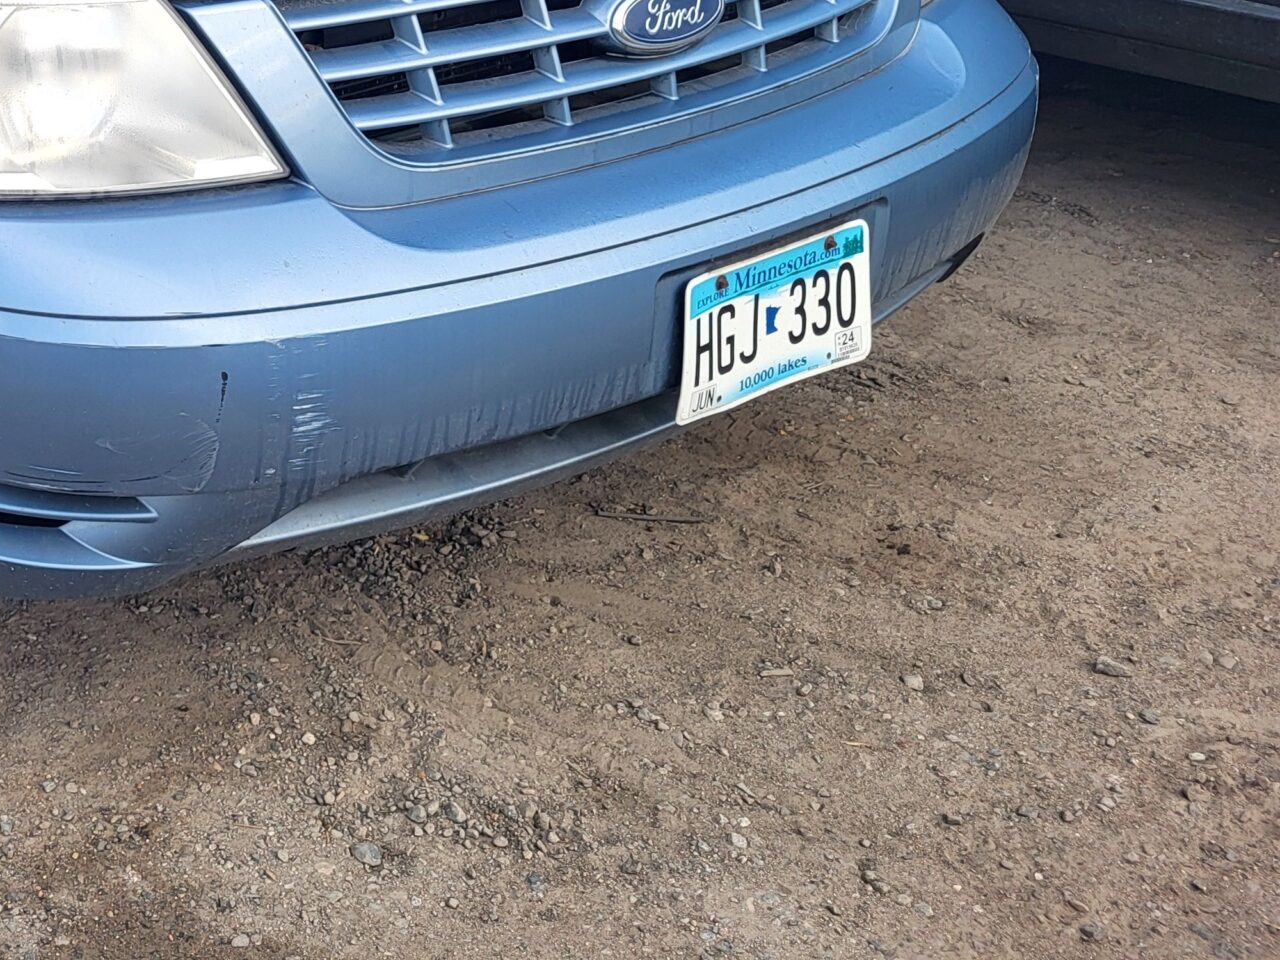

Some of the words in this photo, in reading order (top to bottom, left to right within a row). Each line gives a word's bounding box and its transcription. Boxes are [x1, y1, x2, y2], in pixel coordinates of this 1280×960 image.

[697, 288, 730, 309] EXPLORE
[733, 247, 841, 293] Minnesota.com
[694, 293, 760, 387] HGJ
[788, 262, 857, 344] 330
[841, 330, 855, 346] 24
[738, 366, 775, 391] 10,000
[777, 356, 808, 376] lakes
[692, 388, 715, 413] JUN
